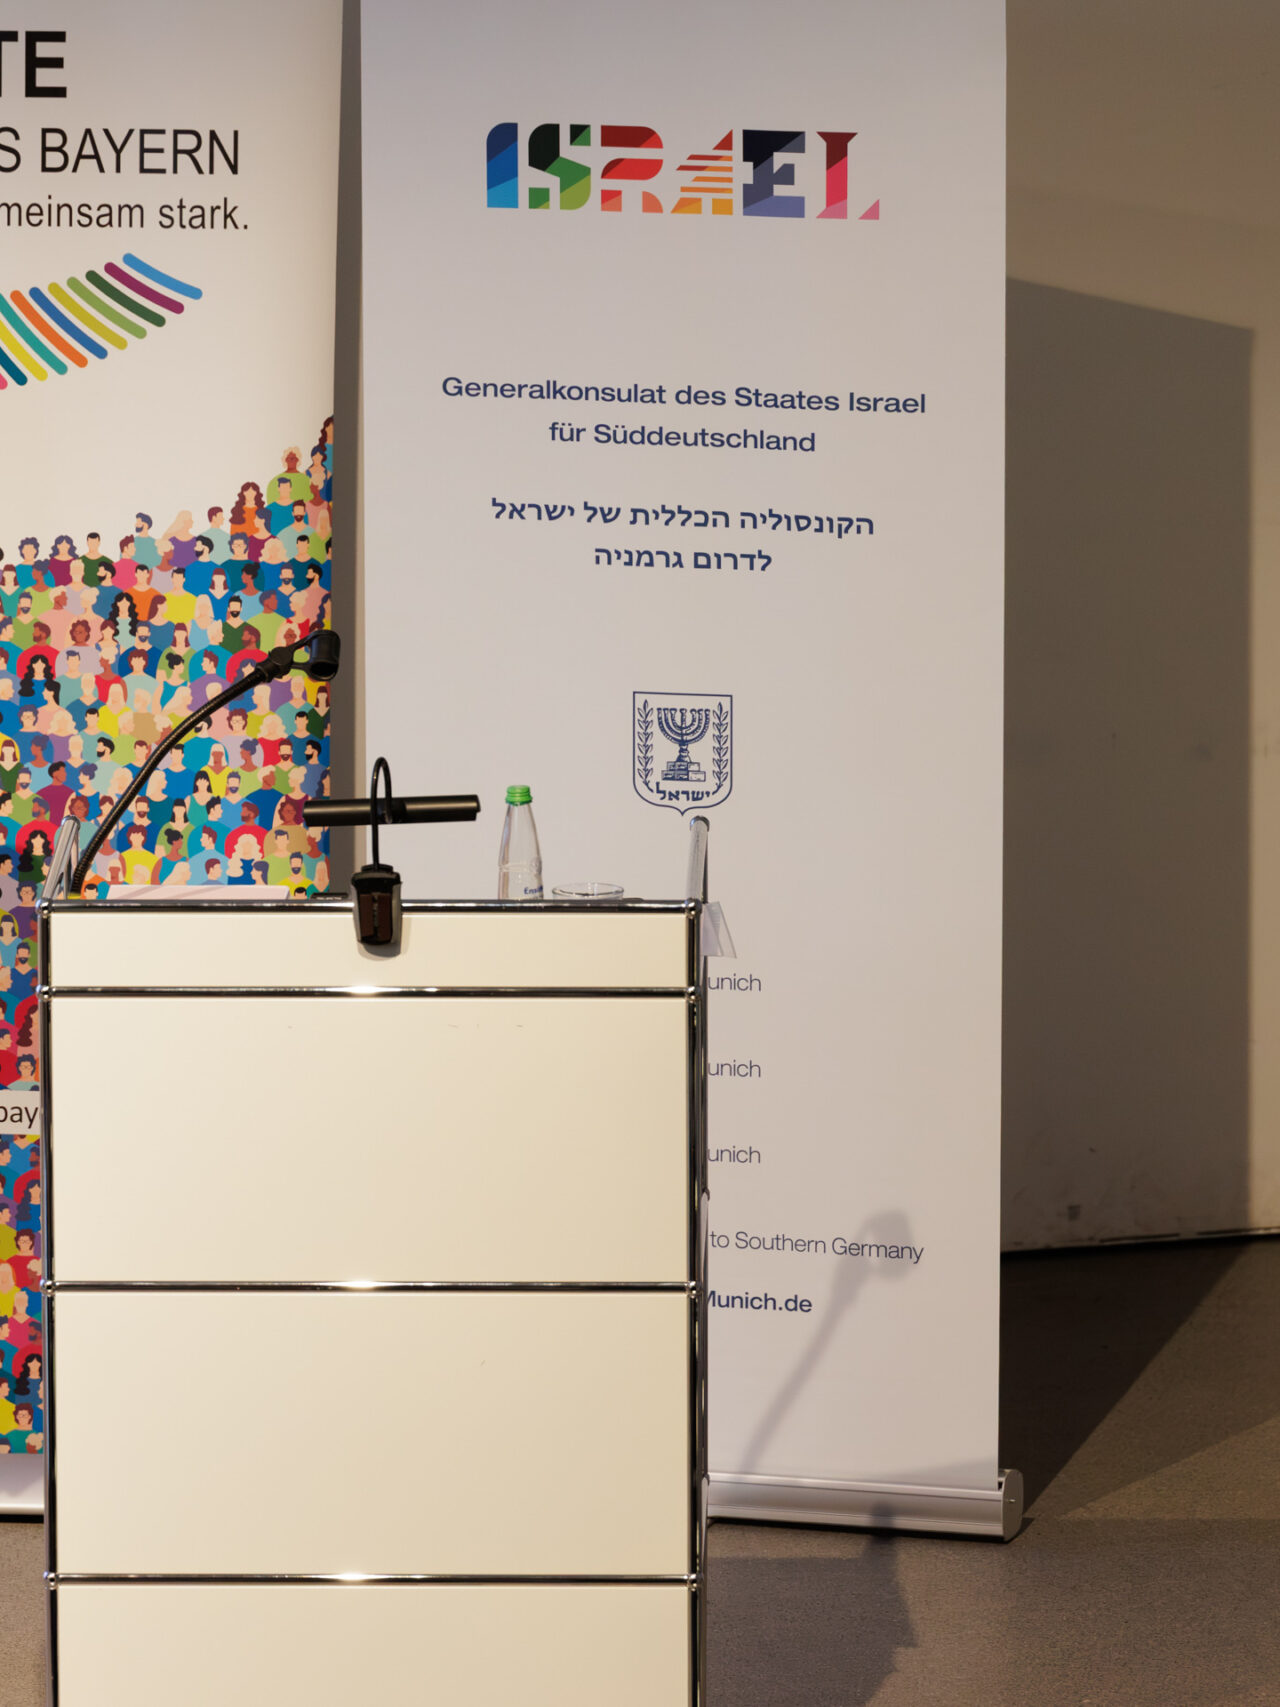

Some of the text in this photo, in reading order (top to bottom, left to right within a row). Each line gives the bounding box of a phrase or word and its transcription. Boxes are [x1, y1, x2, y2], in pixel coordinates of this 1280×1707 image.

[41, 128, 239, 175] BAYERN
[486, 122, 880, 220] ISRAEL
[159, 197, 248, 229] stark.
[442, 377, 925, 413] Generalkonsulat des Staates Israel
[549, 422, 815, 452] für Süddeutschland
[492, 497, 873, 539] הקונסוליה הכללית של ישראל
[595, 548, 772, 571] לדרום גרמניה
[656, 782, 711, 801] ישראל
[710, 1231, 924, 1264] to Southern Germany
